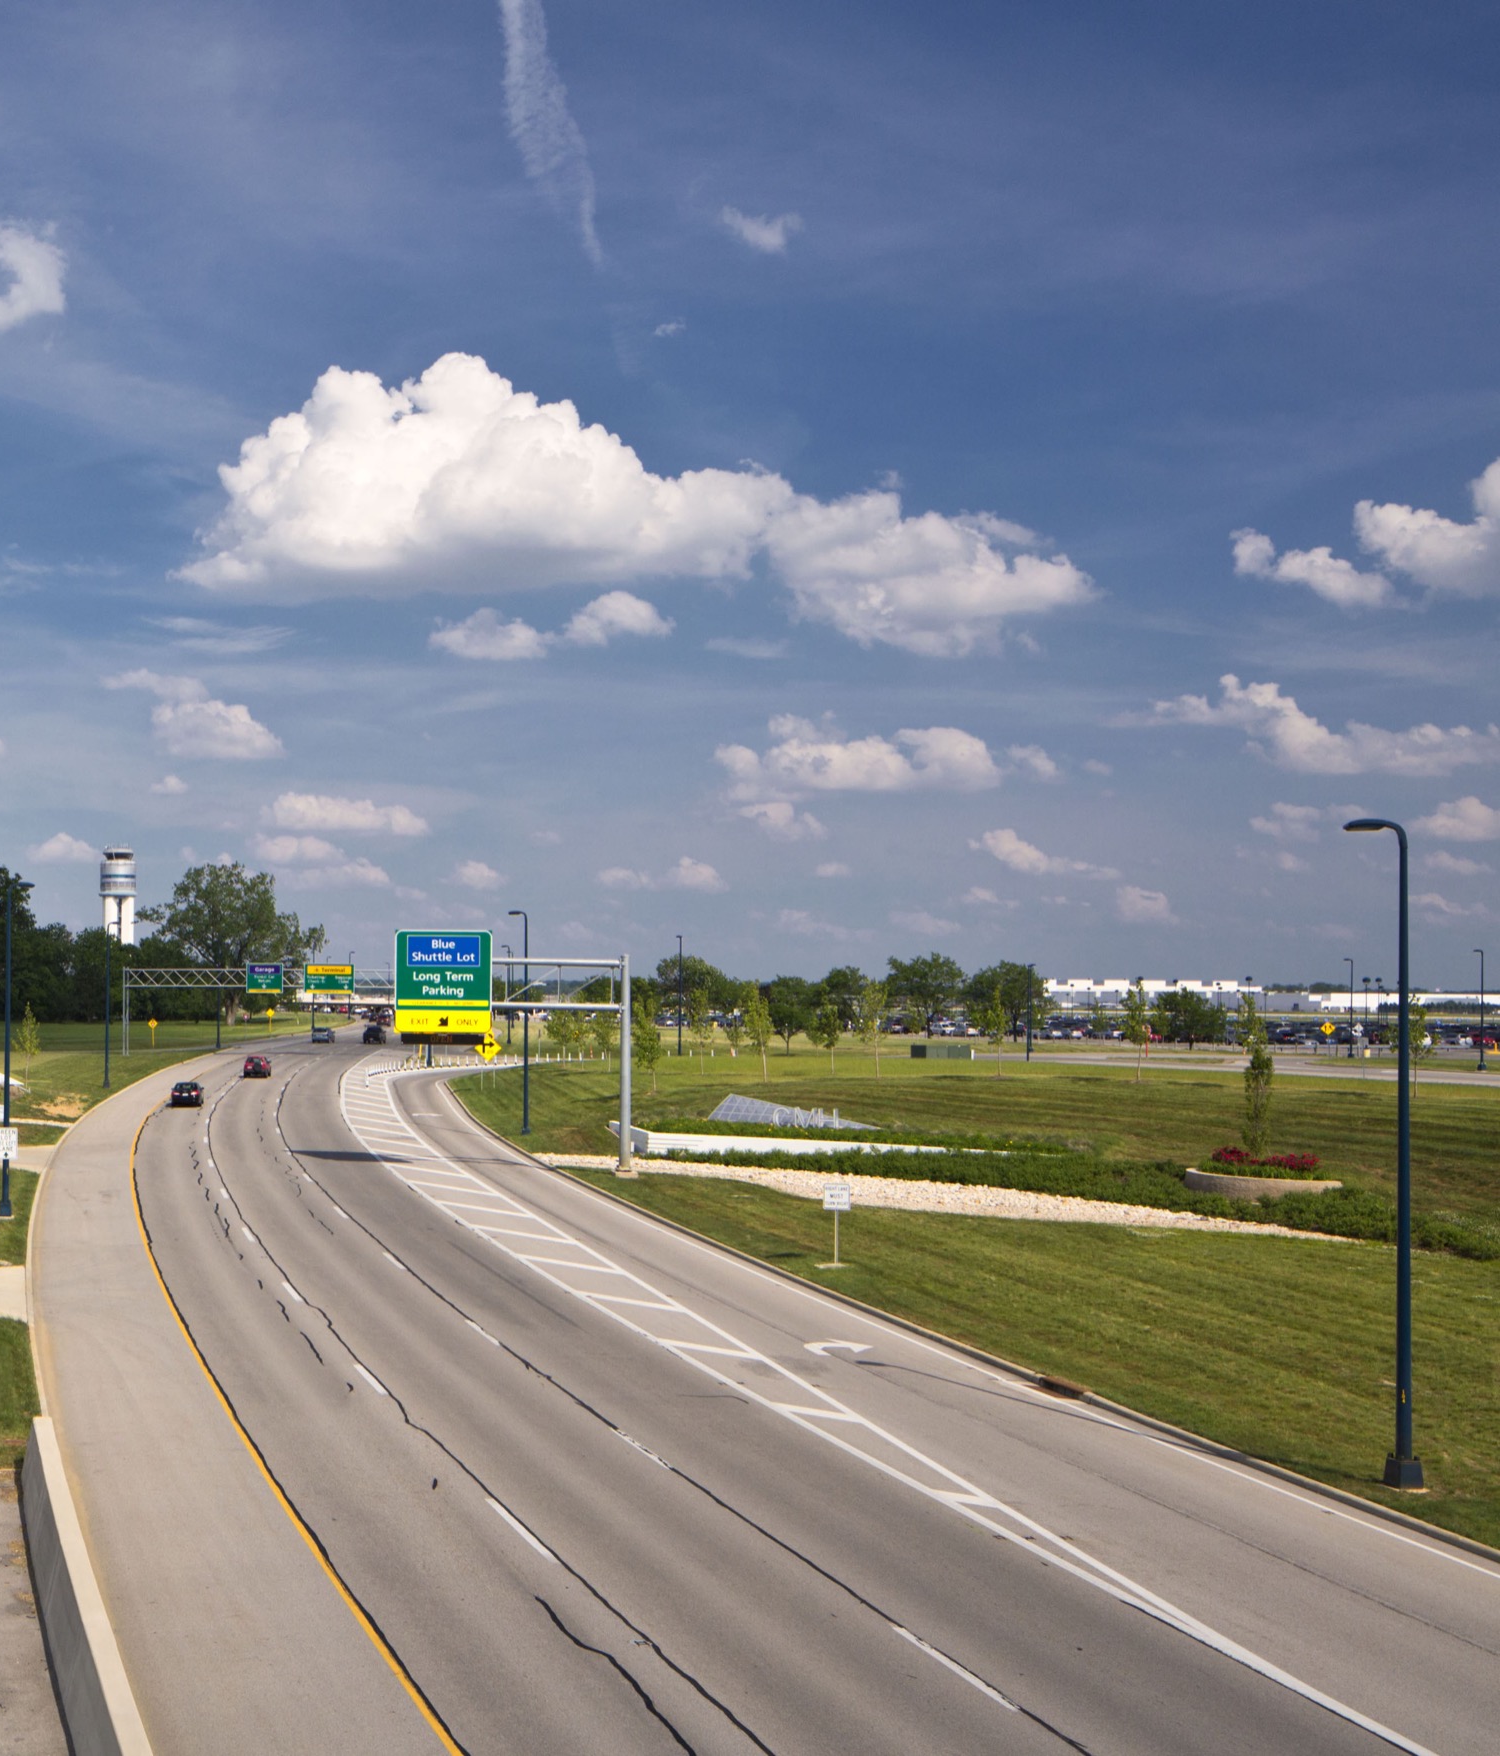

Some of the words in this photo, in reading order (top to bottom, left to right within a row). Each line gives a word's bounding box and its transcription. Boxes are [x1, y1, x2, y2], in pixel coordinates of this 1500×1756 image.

[431, 939, 455, 949] Blue
[412, 951, 452, 962] Shuttle
[457, 952, 475, 962] Lot
[254, 966, 275, 974] Garage
[412, 971, 441, 983] Long
[445, 971, 474, 982] Term
[422, 986, 464, 998] Parking
[456, 1018, 479, 1026] ONLY
[430, 1035, 453, 1043] OPEN
[772, 1106, 839, 1130] CMH
